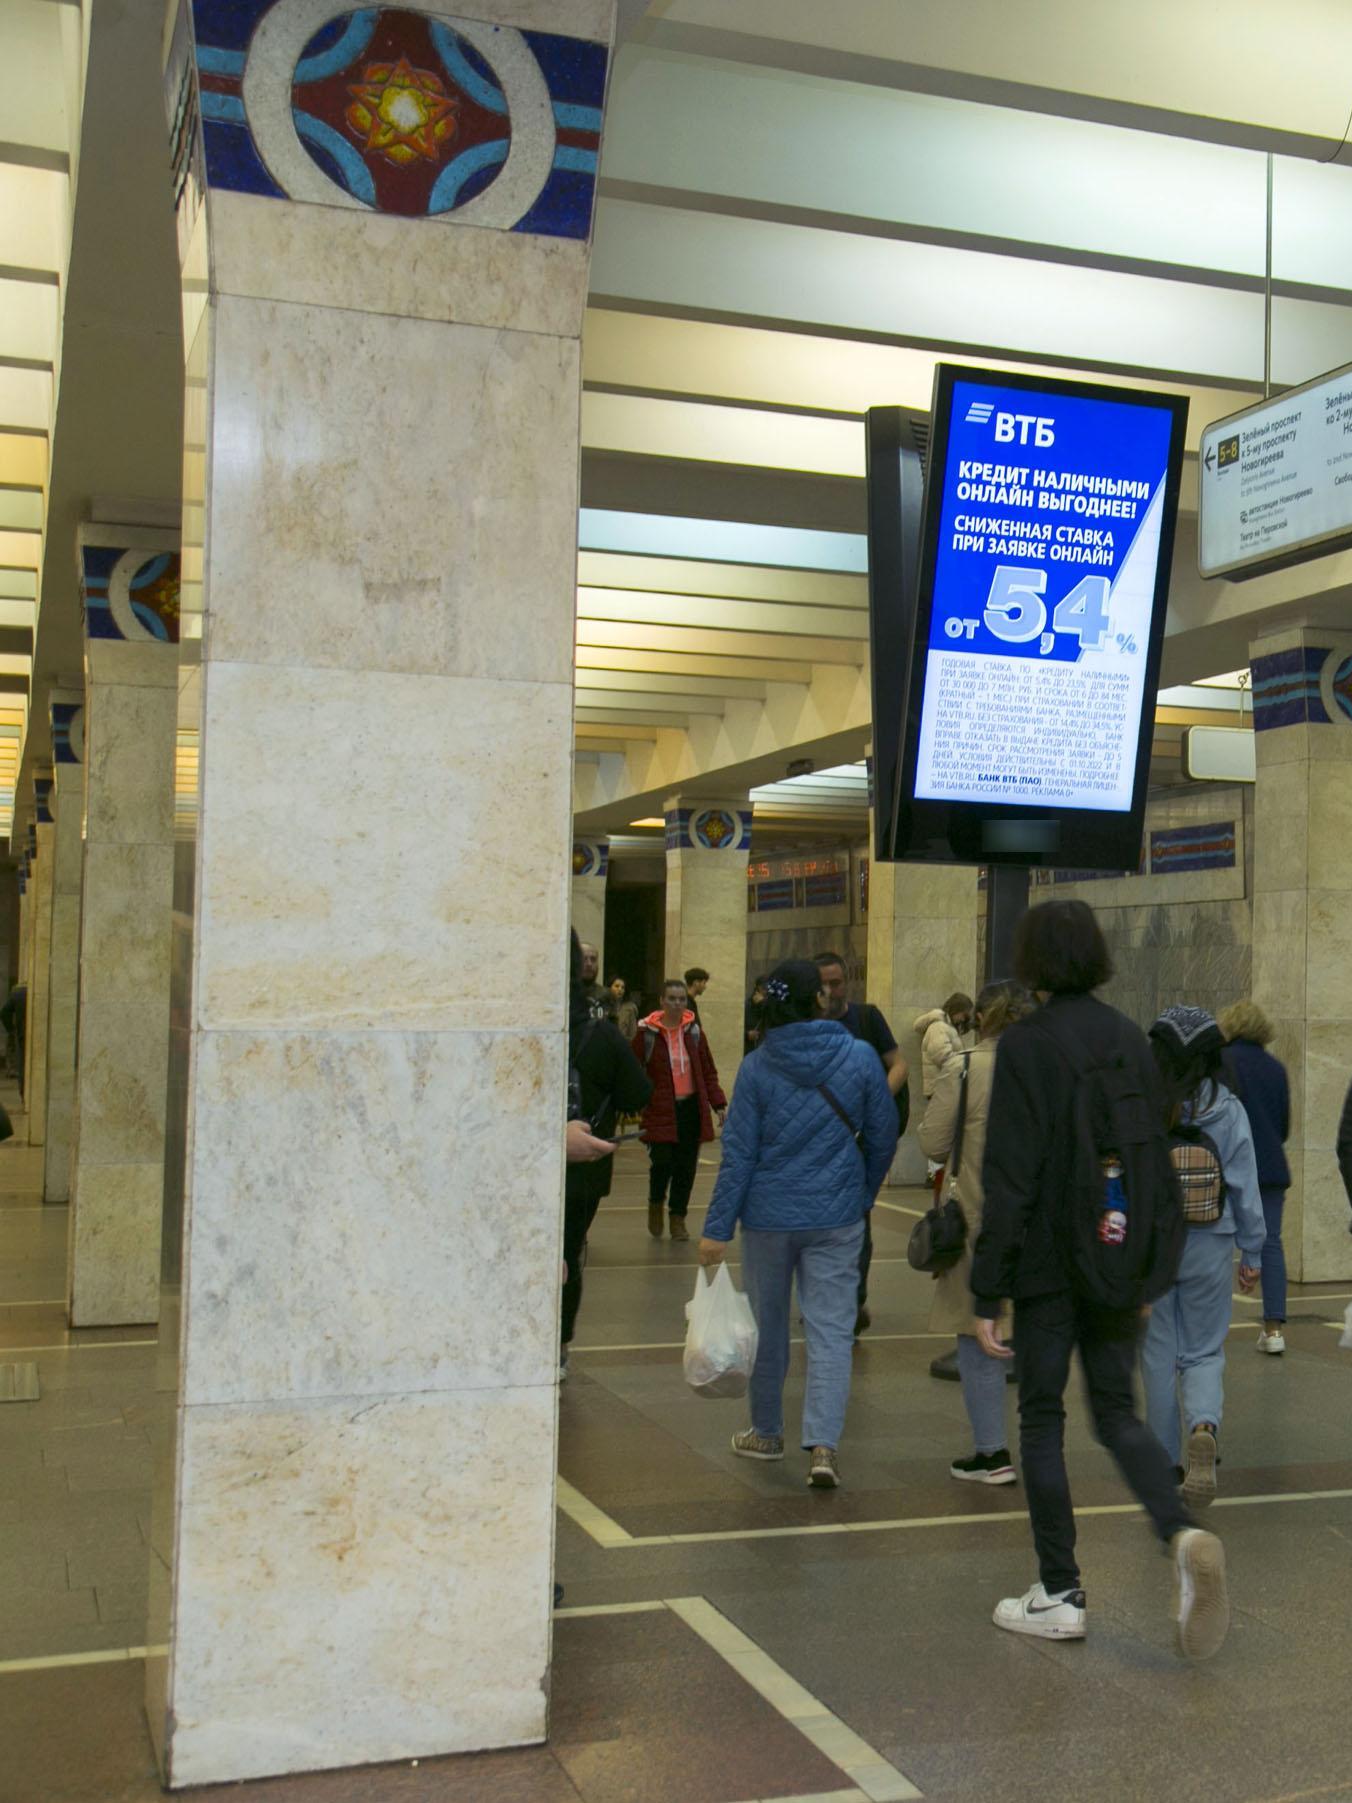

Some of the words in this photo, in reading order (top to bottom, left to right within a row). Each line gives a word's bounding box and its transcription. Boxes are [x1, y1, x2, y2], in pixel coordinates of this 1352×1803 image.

[1326, 415, 1335, 425] ко
[1336, 406, 1352, 422] 2-му
[994, 412, 1055, 447] ВТБ
[1241, 422, 1270, 444] Зелёный
[1269, 412, 1302, 432] проспект
[1220, 441, 1238, 463] 5-8
[1246, 444, 1261, 458] 5-му
[1262, 430, 1297, 449] проспекту
[1241, 450, 1284, 473] Новогиреева
[958, 461, 1029, 486] КРЕДИТ
[1033, 469, 1150, 500] НАЛИЧНЫМИ
[957, 482, 1033, 507] ОНЛАЙН
[1038, 492, 1137, 519] ВЫГОДНЕЕ!
[954, 515, 1051, 540] СНИЖЕННАЯ
[1056, 526, 1114, 547] СТАВКА
[952, 534, 984, 552] ПРИ
[988, 538, 1046, 560] ЗАЯВКЕ
[1050, 543, 1114, 566] ОНЛАЙН
[942, 659, 976, 669] ГОДОВАЯ
[983, 662, 1011, 672] СТАВКА
[1020, 665, 1031, 673] ПО
[941, 669, 956, 678] ПРИ
[959, 671, 985, 681] ЗАЯВКЕ
[1023, 676, 1032, 684] ОТ
[1053, 678, 1064, 687] ДО
[940, 680, 949, 688] ОТ
[952, 681, 961, 689] 30
[978, 683, 989, 691] ДО
[1070, 690, 1079, 698] ОТ
[1088, 691, 1099, 699] ДО
[1015, 696, 1030, 704] ПРИ
[937, 710, 948, 718] НА
[978, 713, 990, 721] БЕЗ
[1049, 718, 1058, 726] ОТ
[1080, 720, 1091, 729] ДО
[1104, 752, 1115, 760] ДО
[932, 760, 959, 770] ЛЮБОЙ
[960, 762, 991, 772] МОМЕНТ
[993, 764, 1016, 774] МОГУТ
[937, 771, 948, 780] НА
[978, 774, 1000, 783] БАНК
[1002, 775, 1018, 784] ВТБ
[930, 781, 945, 789] ЗИЯ
[946, 782, 970, 791] БАНКА
[972, 784, 1002, 793] РОССИИ
[1031, 787, 1065, 797] РЕКЛАМА
